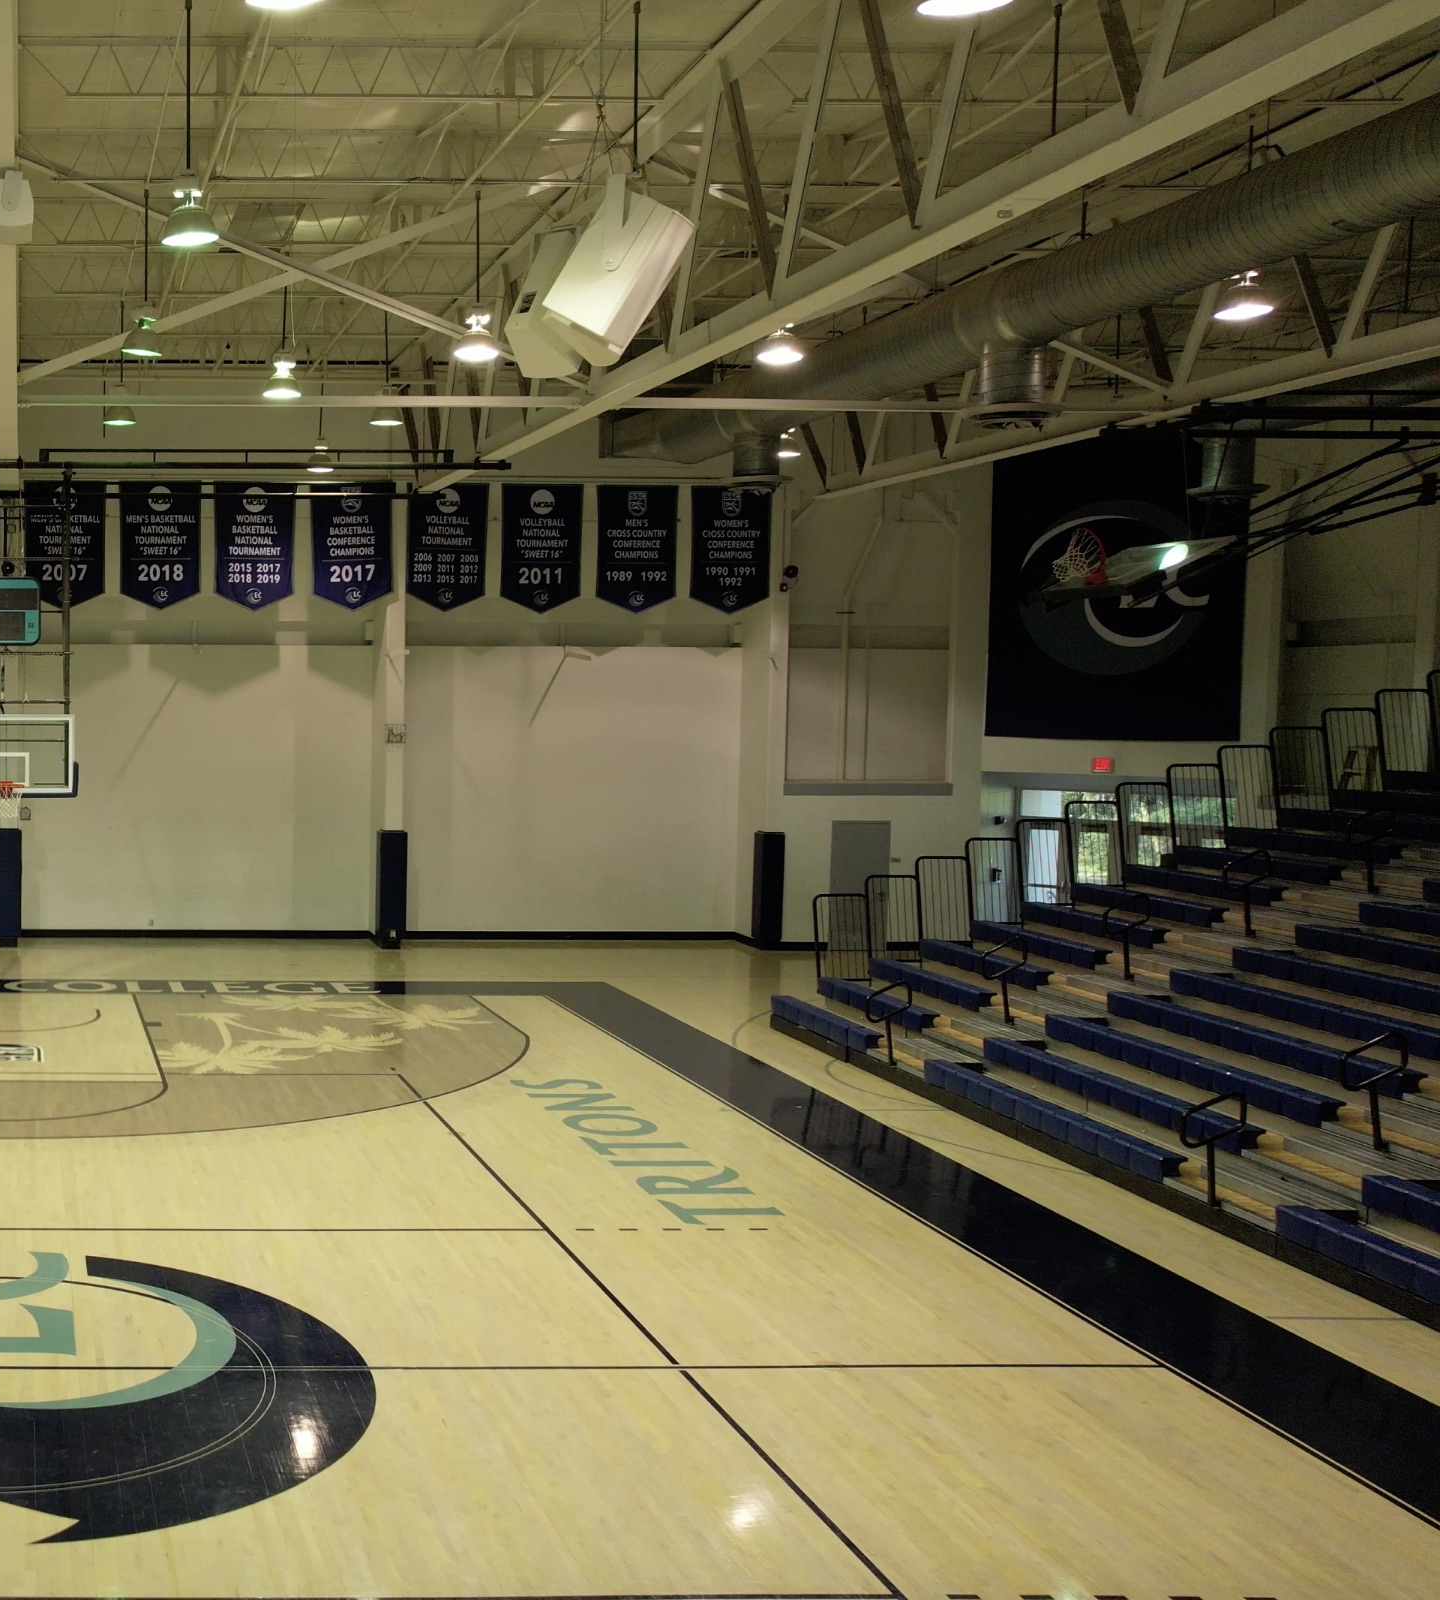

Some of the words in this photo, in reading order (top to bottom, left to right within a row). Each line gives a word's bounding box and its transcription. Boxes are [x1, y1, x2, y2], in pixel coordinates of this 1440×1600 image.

[126, 515, 148, 523] MEN'S
[150, 515, 195, 523] BASKETBALL
[236, 515, 273, 523] WOMEN'S
[333, 515, 369, 524] WOMEN'S
[426, 515, 470, 525] VOLLEYBALL
[520, 518, 565, 526] VOLLEYBALL
[625, 519, 648, 527] MEN'S
[714, 520, 749, 528] WOMEN'S
[141, 526, 179, 534] NATIONAL
[232, 526, 278, 534] BASKETBALL
[330, 526, 374, 535] BASKETBALL
[428, 526, 464, 535] NATIONAL
[522, 528, 560, 537] NATIONAL
[607, 530, 630, 538] CROSS
[632, 530, 667, 538] COUNTRY
[702, 530, 726, 538] CROSS
[727, 530, 760, 538] COUNTRY
[135, 536, 187, 544] TOURNAMENT
[235, 536, 273, 545] NATIONAL
[327, 536, 375, 545] CONFERENCE
[422, 536, 472, 546] TOURNAMENT
[516, 539, 568, 548] TOURNAMENT
[613, 540, 660, 548] CONFERENCE
[708, 541, 754, 549] CONFERENCE
[229, 547, 281, 555] TOURNAMENT
[330, 547, 374, 556] CHAMPIONS
[615, 551, 658, 559] CHAMPIONS
[709, 551, 752, 559] CHAMPIONS
[414, 553, 432, 562] 2006
[437, 554, 455, 562] 2007
[460, 554, 479, 563] 2008
[228, 563, 252, 572] 2015
[257, 563, 280, 572] 2017
[414, 564, 432, 572] 2009
[437, 565, 454, 573] 2011
[460, 565, 478, 573] 2012
[705, 567, 728, 575] 1990
[733, 567, 755, 575] 1991
[138, 564, 183, 581] 2018
[330, 564, 375, 582] 2017
[519, 567, 562, 584] 2011
[606, 571, 632, 581] 1989
[641, 571, 667, 581] 1992
[228, 574, 252, 583] 2018
[257, 574, 280, 583] 2019
[413, 574, 431, 582] 2013
[437, 575, 454, 583] 2015
[460, 576, 477, 584] 2017
[719, 578, 742, 586] 1992
[4, 979, 382, 995] COLLEGE
[510, 1079, 786, 1225] TRITONS
